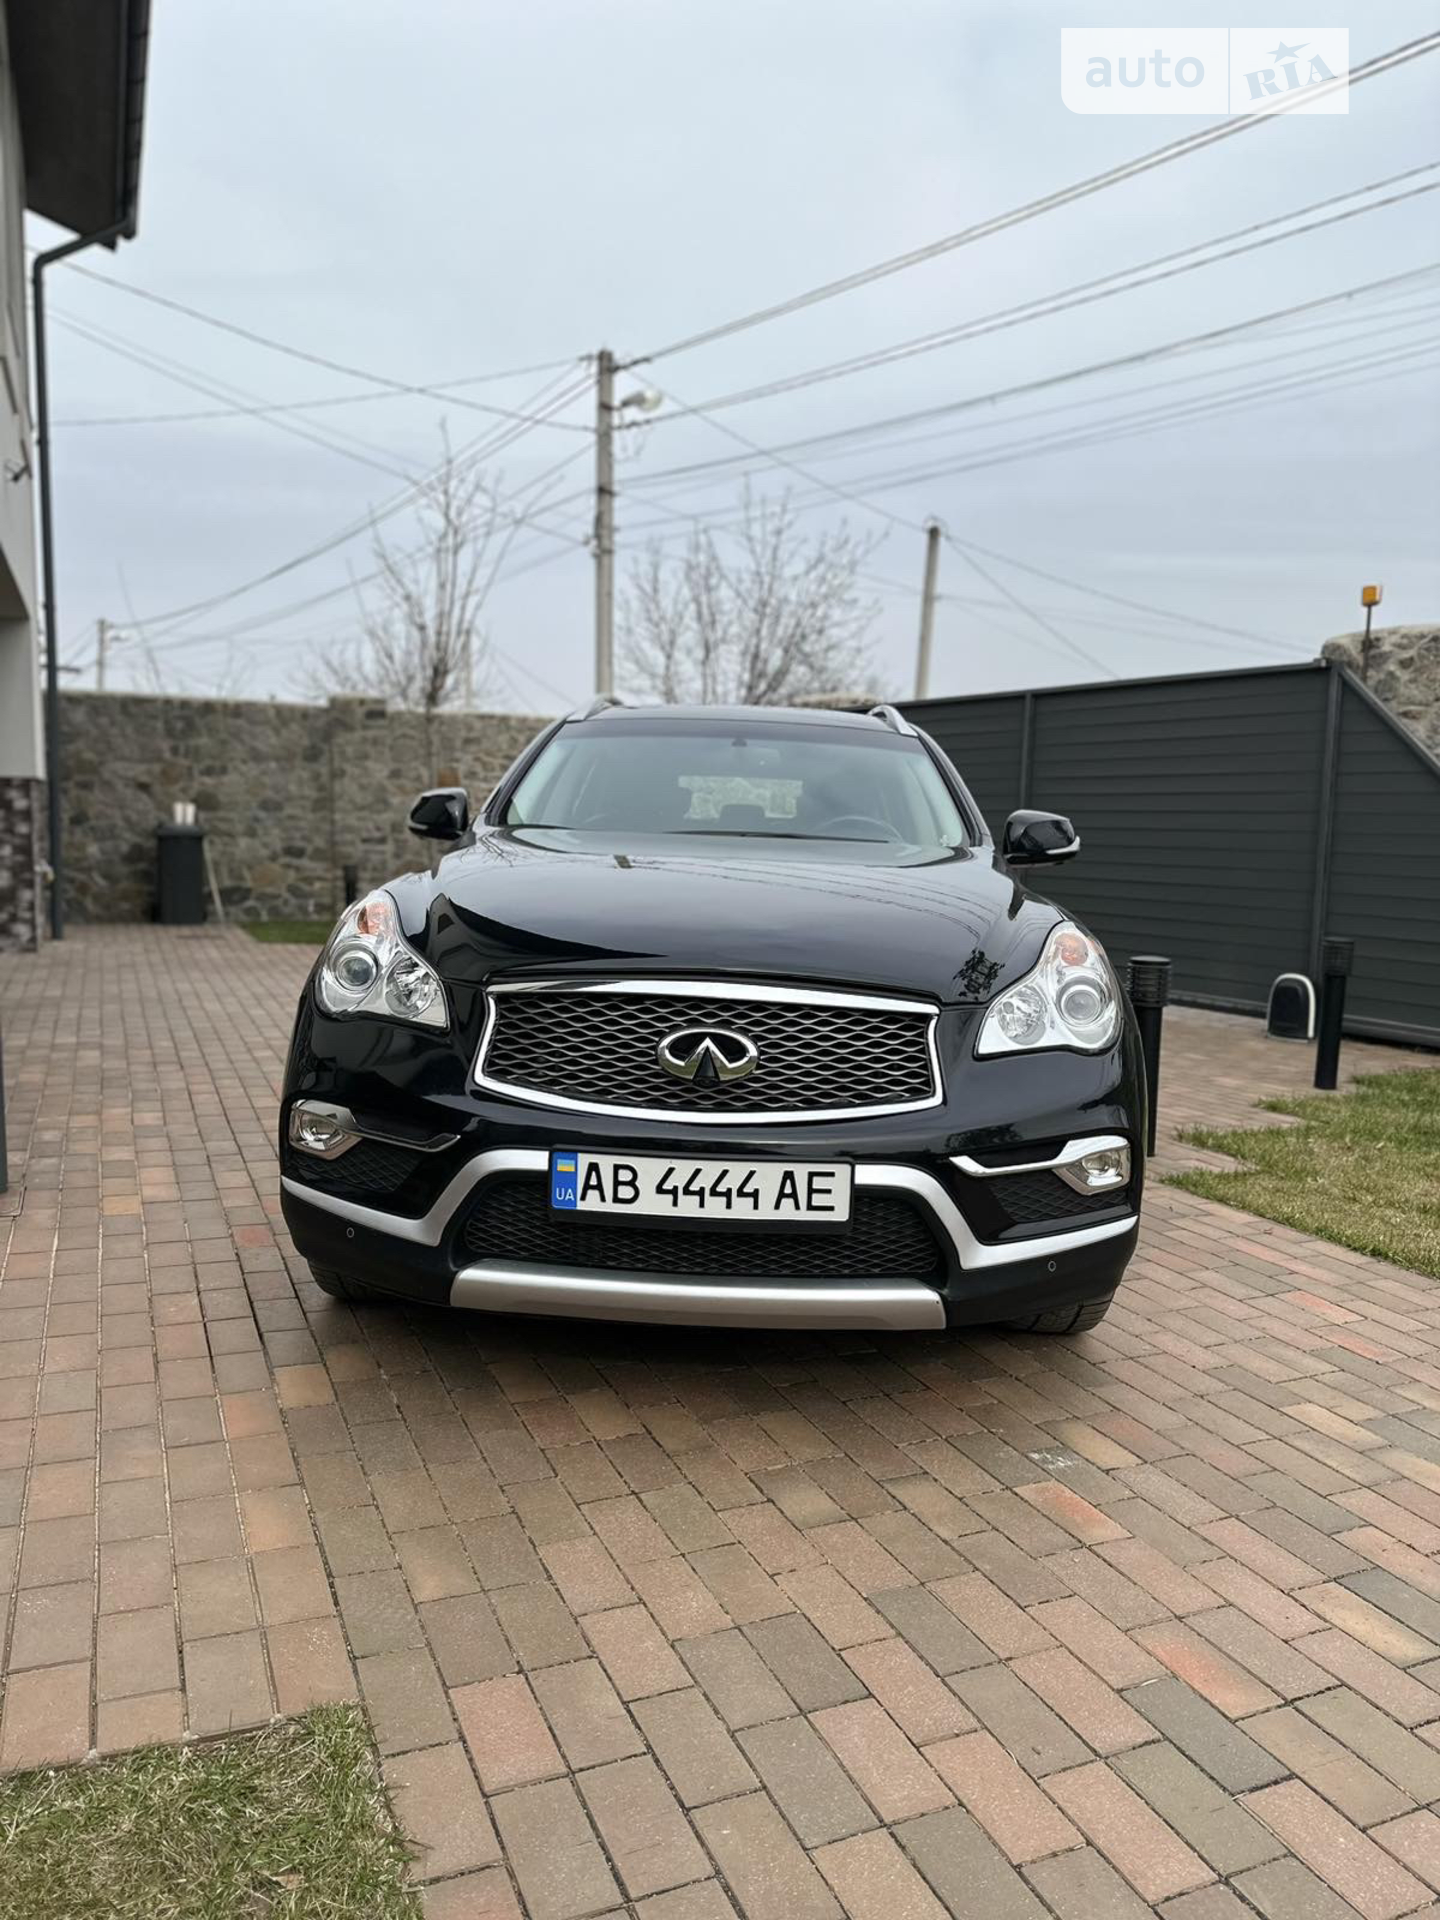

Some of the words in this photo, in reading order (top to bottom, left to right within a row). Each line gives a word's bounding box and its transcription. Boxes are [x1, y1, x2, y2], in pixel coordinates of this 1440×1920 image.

[555, 1188, 575, 1201] UA
[579, 1161, 640, 1205] AB
[655, 1166, 760, 1211] 4444
[773, 1170, 836, 1212] AE
